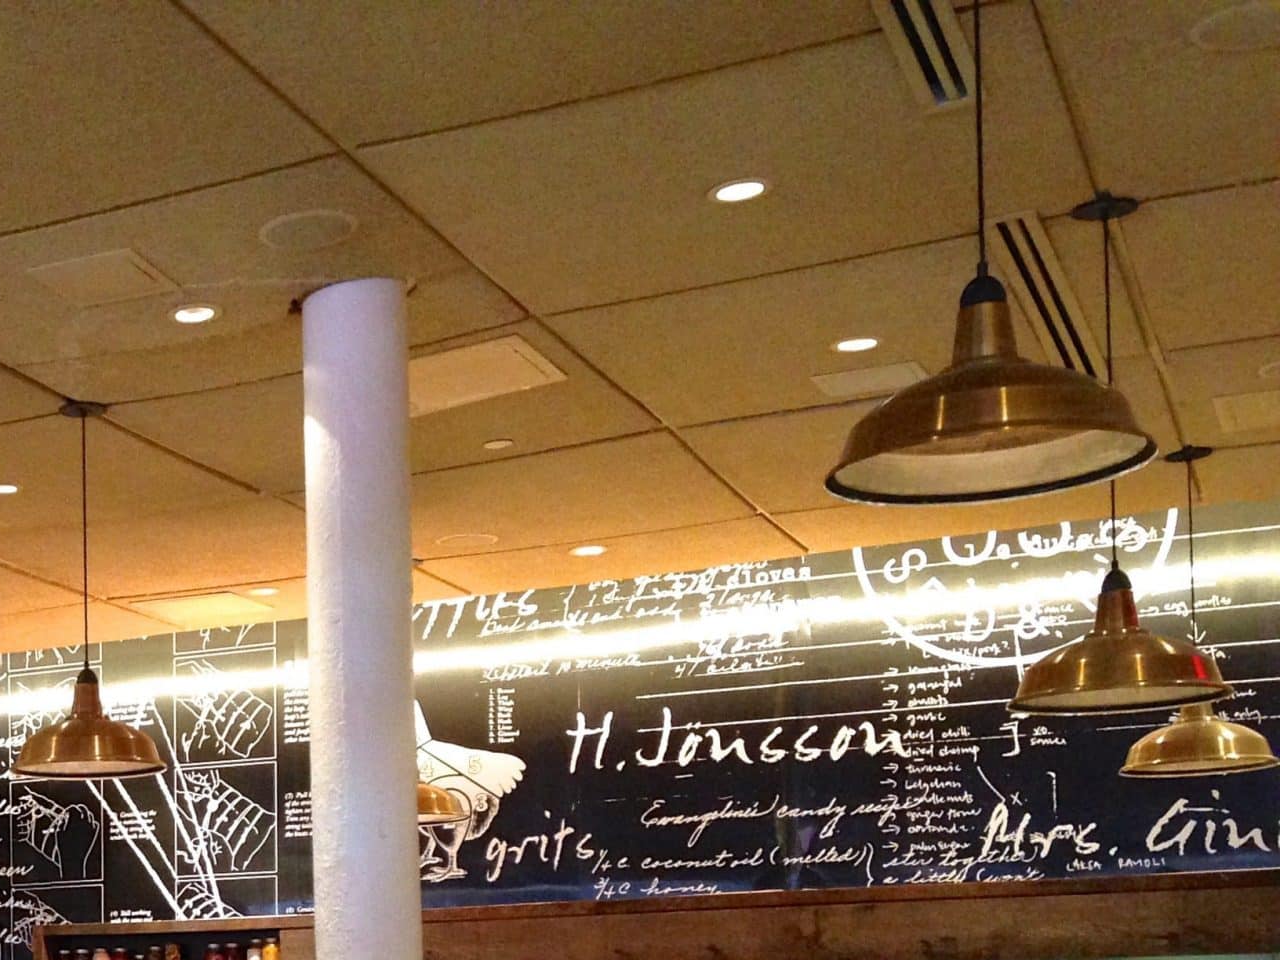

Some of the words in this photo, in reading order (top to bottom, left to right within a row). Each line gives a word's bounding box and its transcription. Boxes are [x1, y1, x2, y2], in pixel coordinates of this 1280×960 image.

[467, 753, 483, 776] 5
[565, 710, 628, 775] H.
[474, 791, 489, 812] 3
[485, 810, 596, 884] grits
